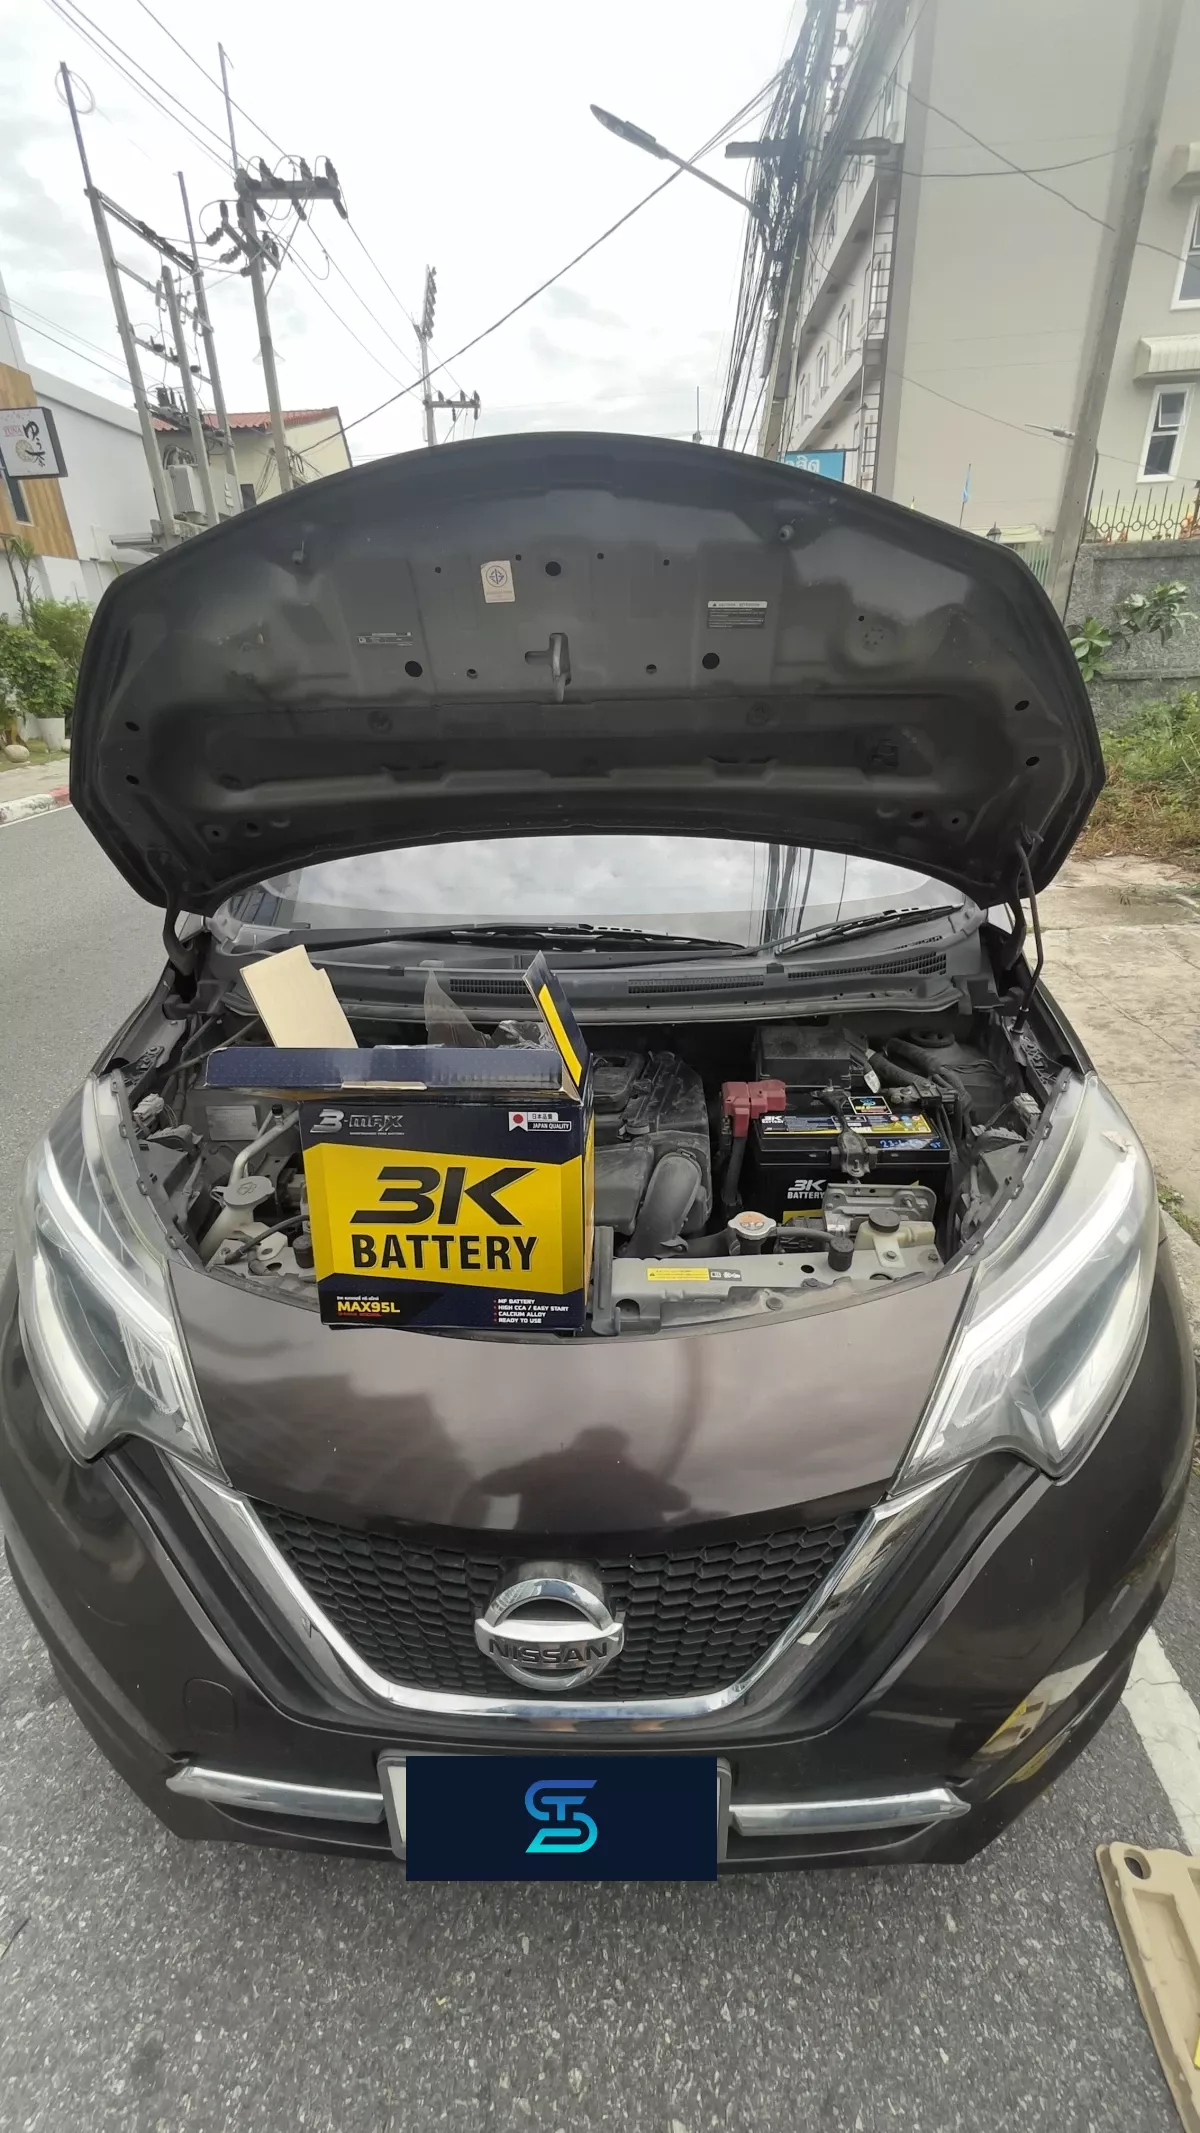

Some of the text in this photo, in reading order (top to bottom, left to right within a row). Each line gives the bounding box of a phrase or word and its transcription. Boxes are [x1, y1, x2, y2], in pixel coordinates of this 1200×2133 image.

[788, 1179, 827, 1191] 3K
[350, 1166, 538, 1226] 3K
[787, 1191, 825, 1199] BATTERY
[351, 1234, 538, 1272] BATTERY
[337, 1301, 401, 1313] MAX95L
[488, 1637, 608, 1664] NISSAN
